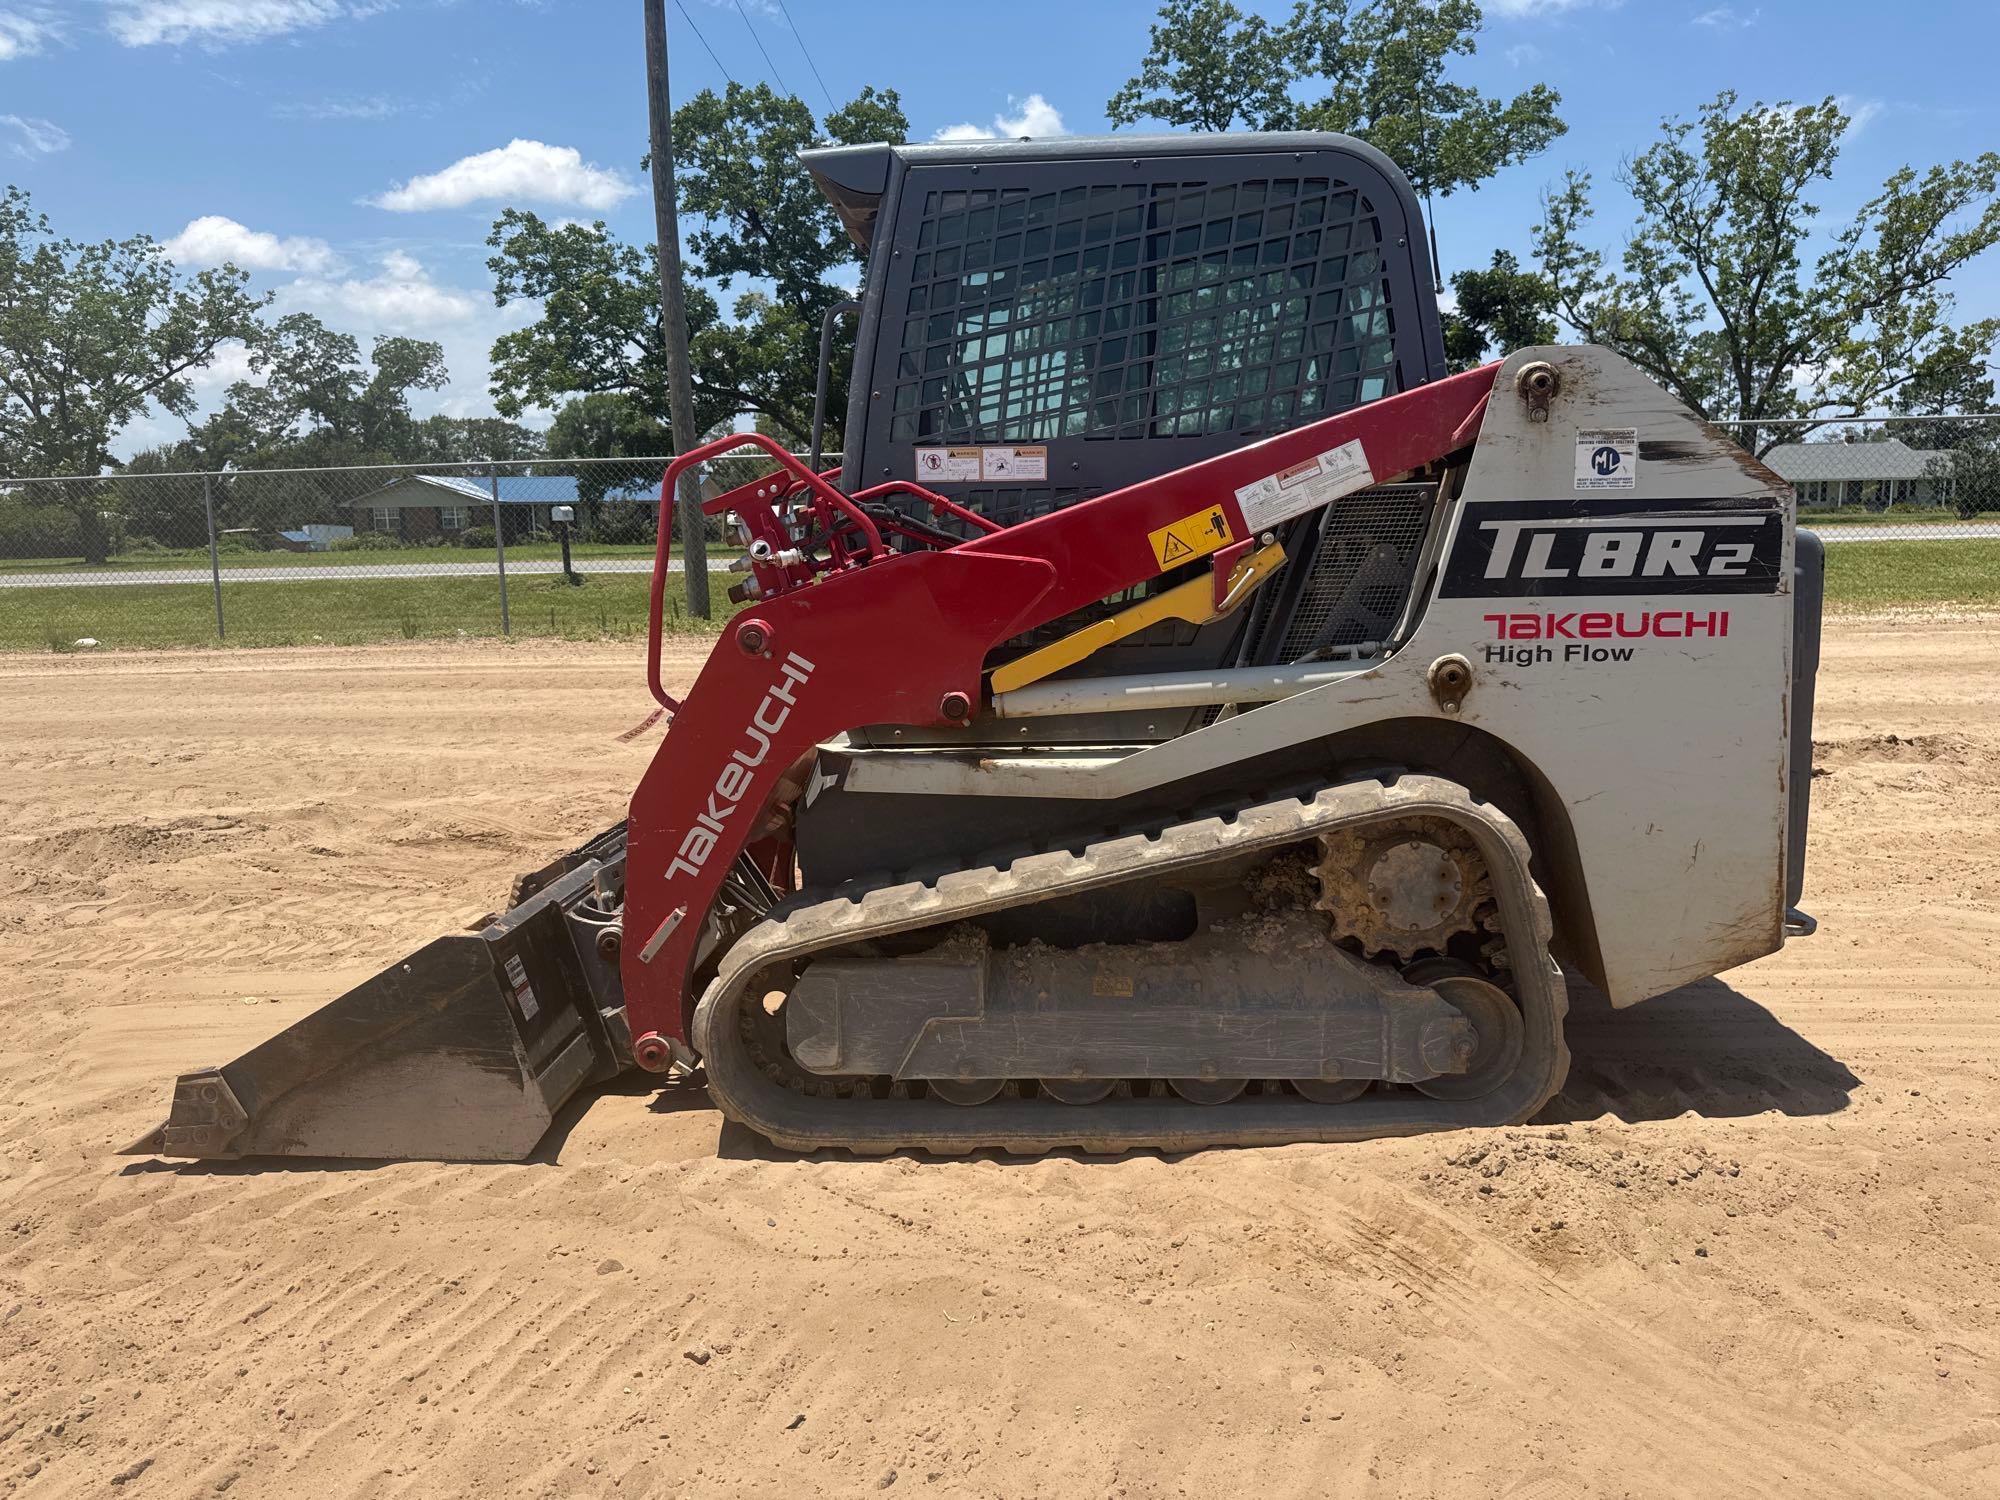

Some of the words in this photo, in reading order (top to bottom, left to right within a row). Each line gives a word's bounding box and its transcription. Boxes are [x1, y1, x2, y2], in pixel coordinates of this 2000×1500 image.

[1479, 515, 1767, 580] TL8R2
[1485, 644, 1553, 667] High
[1564, 644, 1635, 663] Flow
